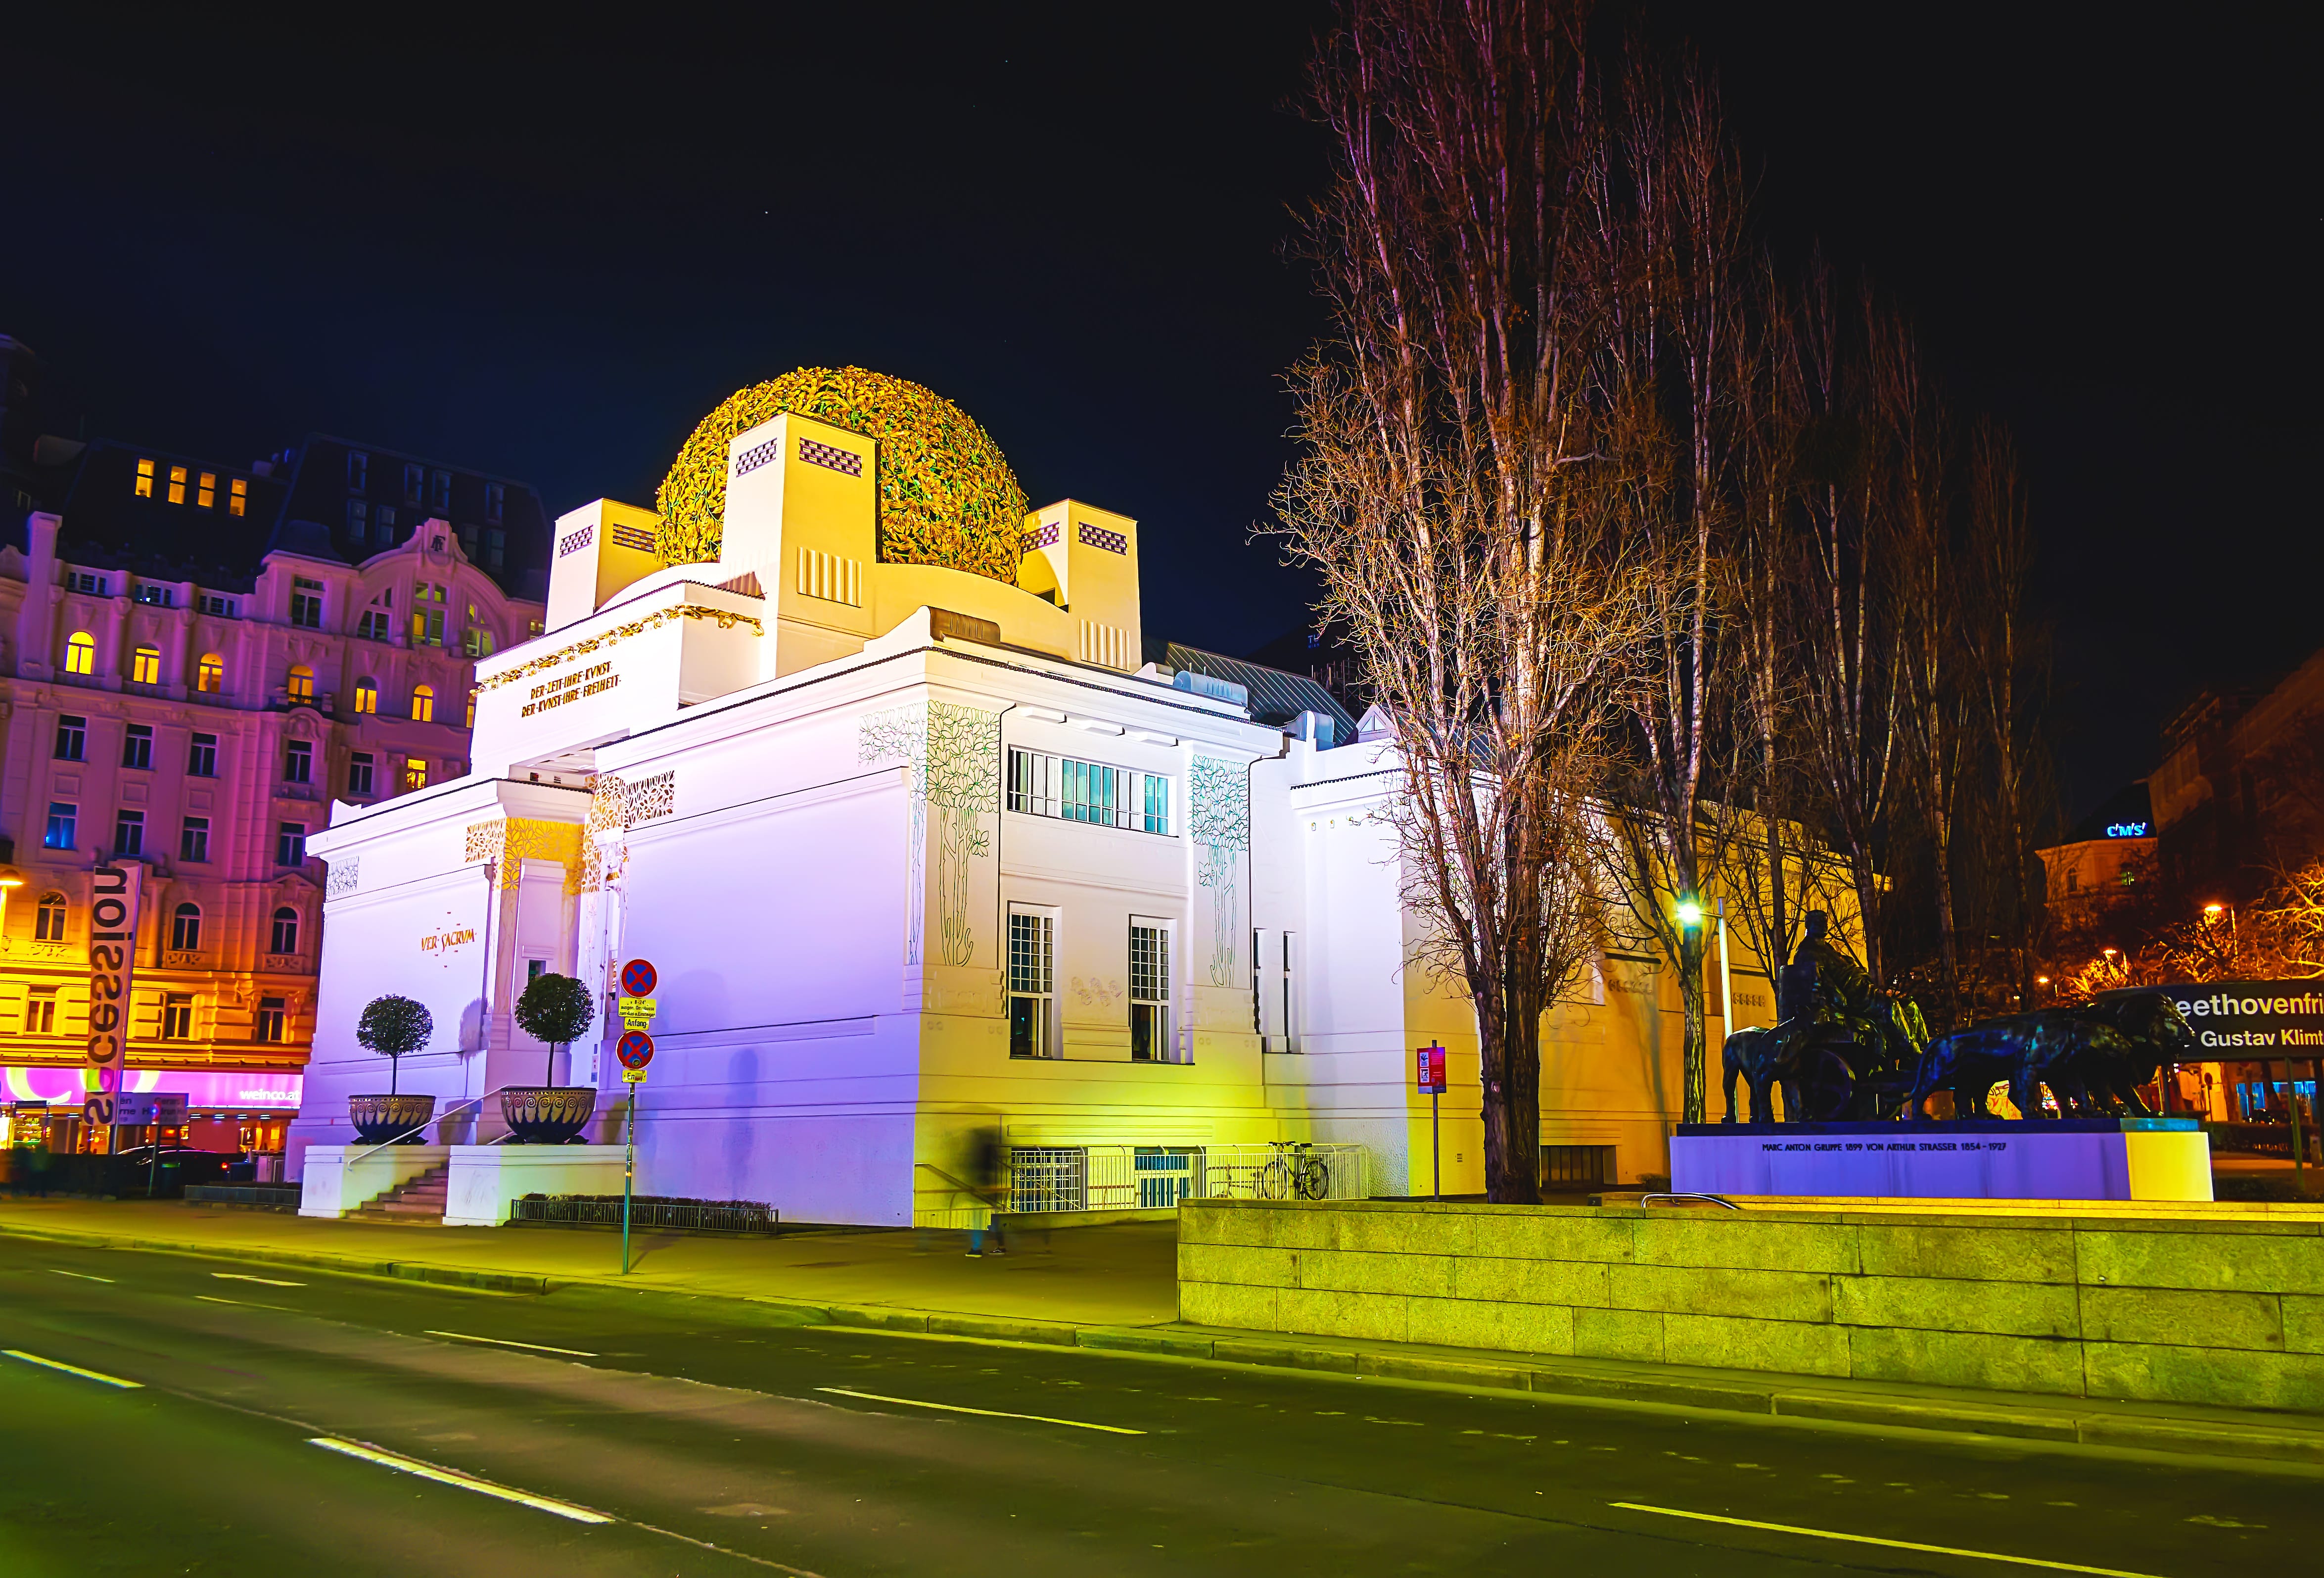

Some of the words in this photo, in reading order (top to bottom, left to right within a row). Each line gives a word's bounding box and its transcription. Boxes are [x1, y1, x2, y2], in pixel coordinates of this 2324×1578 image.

[2176, 992, 2324, 1017] eethovenfri
[627, 1019, 647, 1028] Anfang
[2201, 1030, 2276, 1047] Gustav
[2281, 1029, 2324, 1046] Klimt
[239, 1089, 301, 1100] weinco.at
